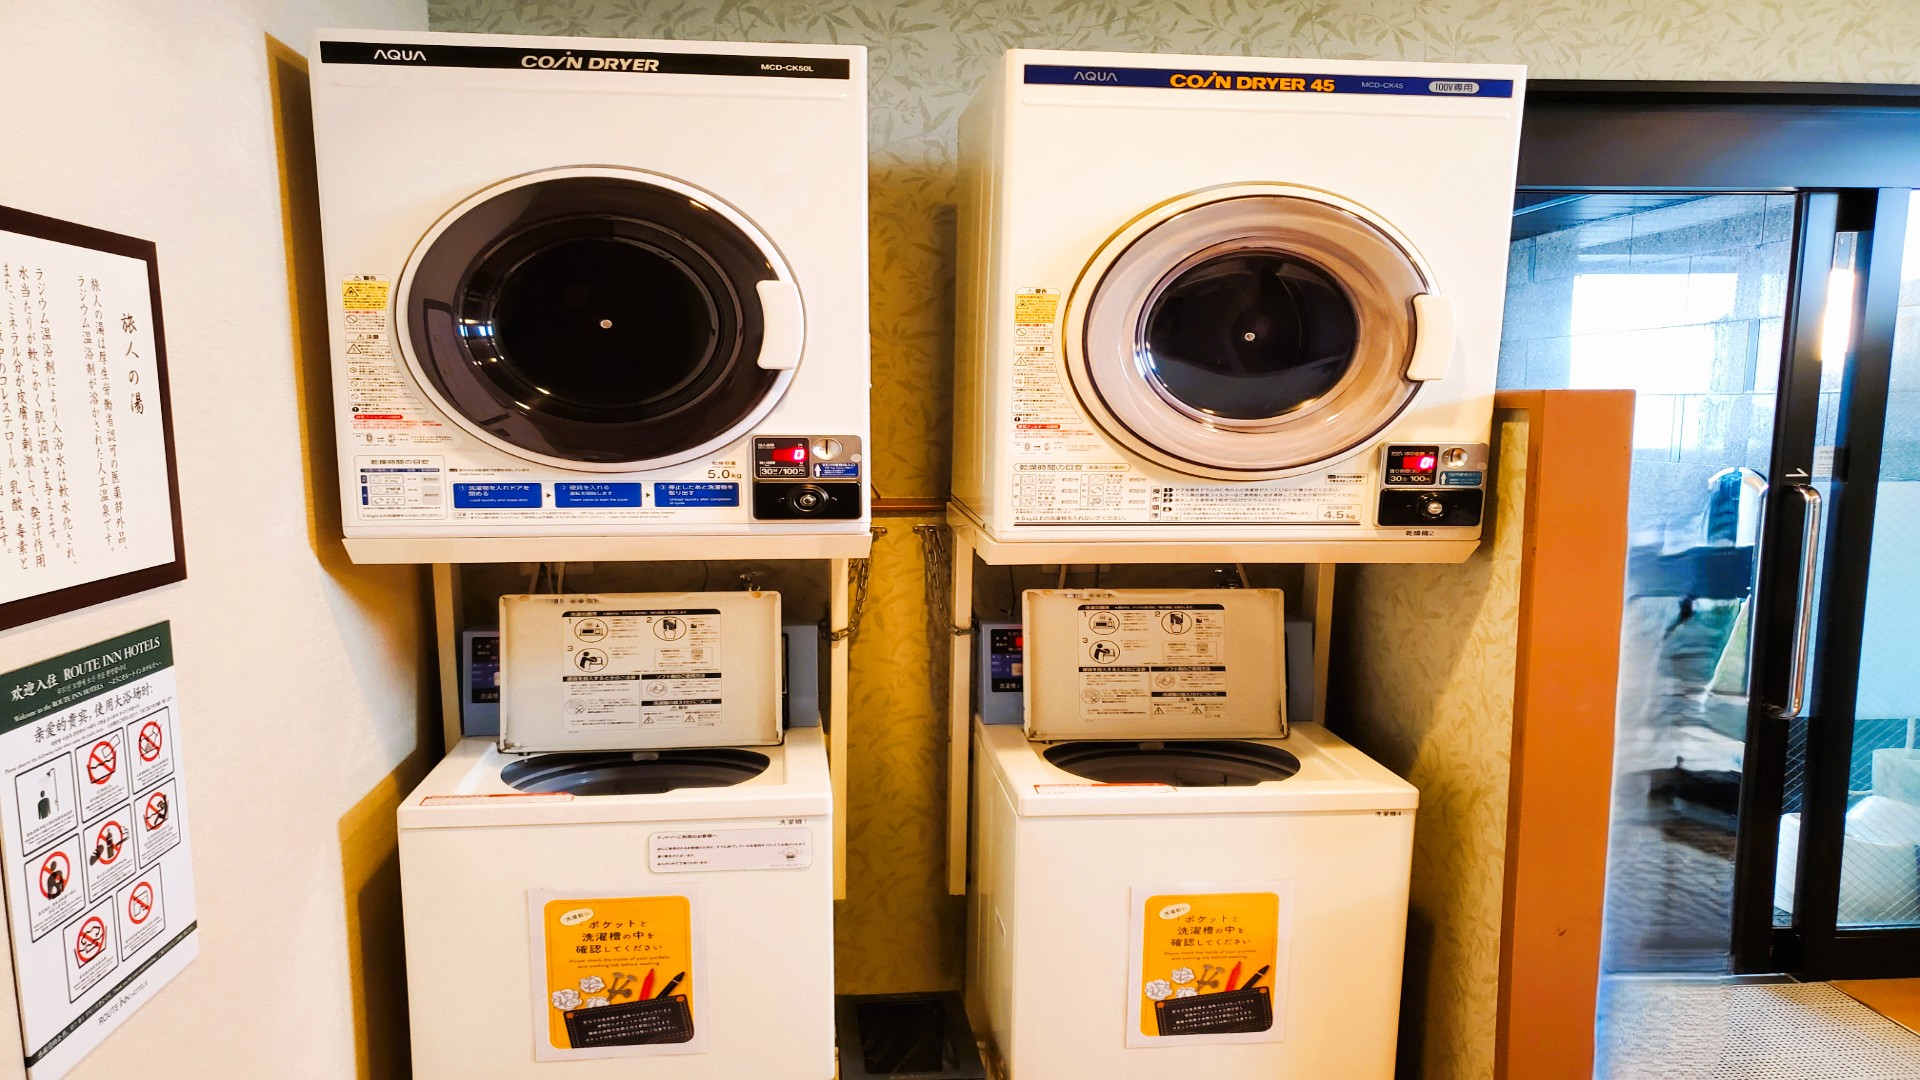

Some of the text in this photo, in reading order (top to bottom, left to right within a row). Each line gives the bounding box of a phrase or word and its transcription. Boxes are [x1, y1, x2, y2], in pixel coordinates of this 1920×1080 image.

[374, 49, 427, 61] AQUA
[521, 51, 660, 72] COIN DRYER
[760, 63, 815, 73] MCD-CK50L
[1074, 71, 1118, 83] AQUA
[1170, 72, 1335, 92] COIN DRYER 45
[1361, 81, 1404, 90] MCD-CK45
[1435, 83, 1473, 92] 100V専用
[120, 312, 145, 415] 旅人の湯
[11, 636, 160, 701] 欢迎入住 ROUTE INN HOTELS
[52, 696, 71, 708] ROUTE
[72, 691, 83, 700] INN
[83, 683, 104, 696] HOTELS
[589, 920, 648, 929] ポケットと
[1185, 915, 1238, 924] ポケットと
[1178, 926, 1244, 936] 洗濯槽の中を
[582, 931, 655, 942] 洗濯槽の中を
[1171, 938, 1251, 947] 確認してください
[576, 944, 663, 954] 確認してください
